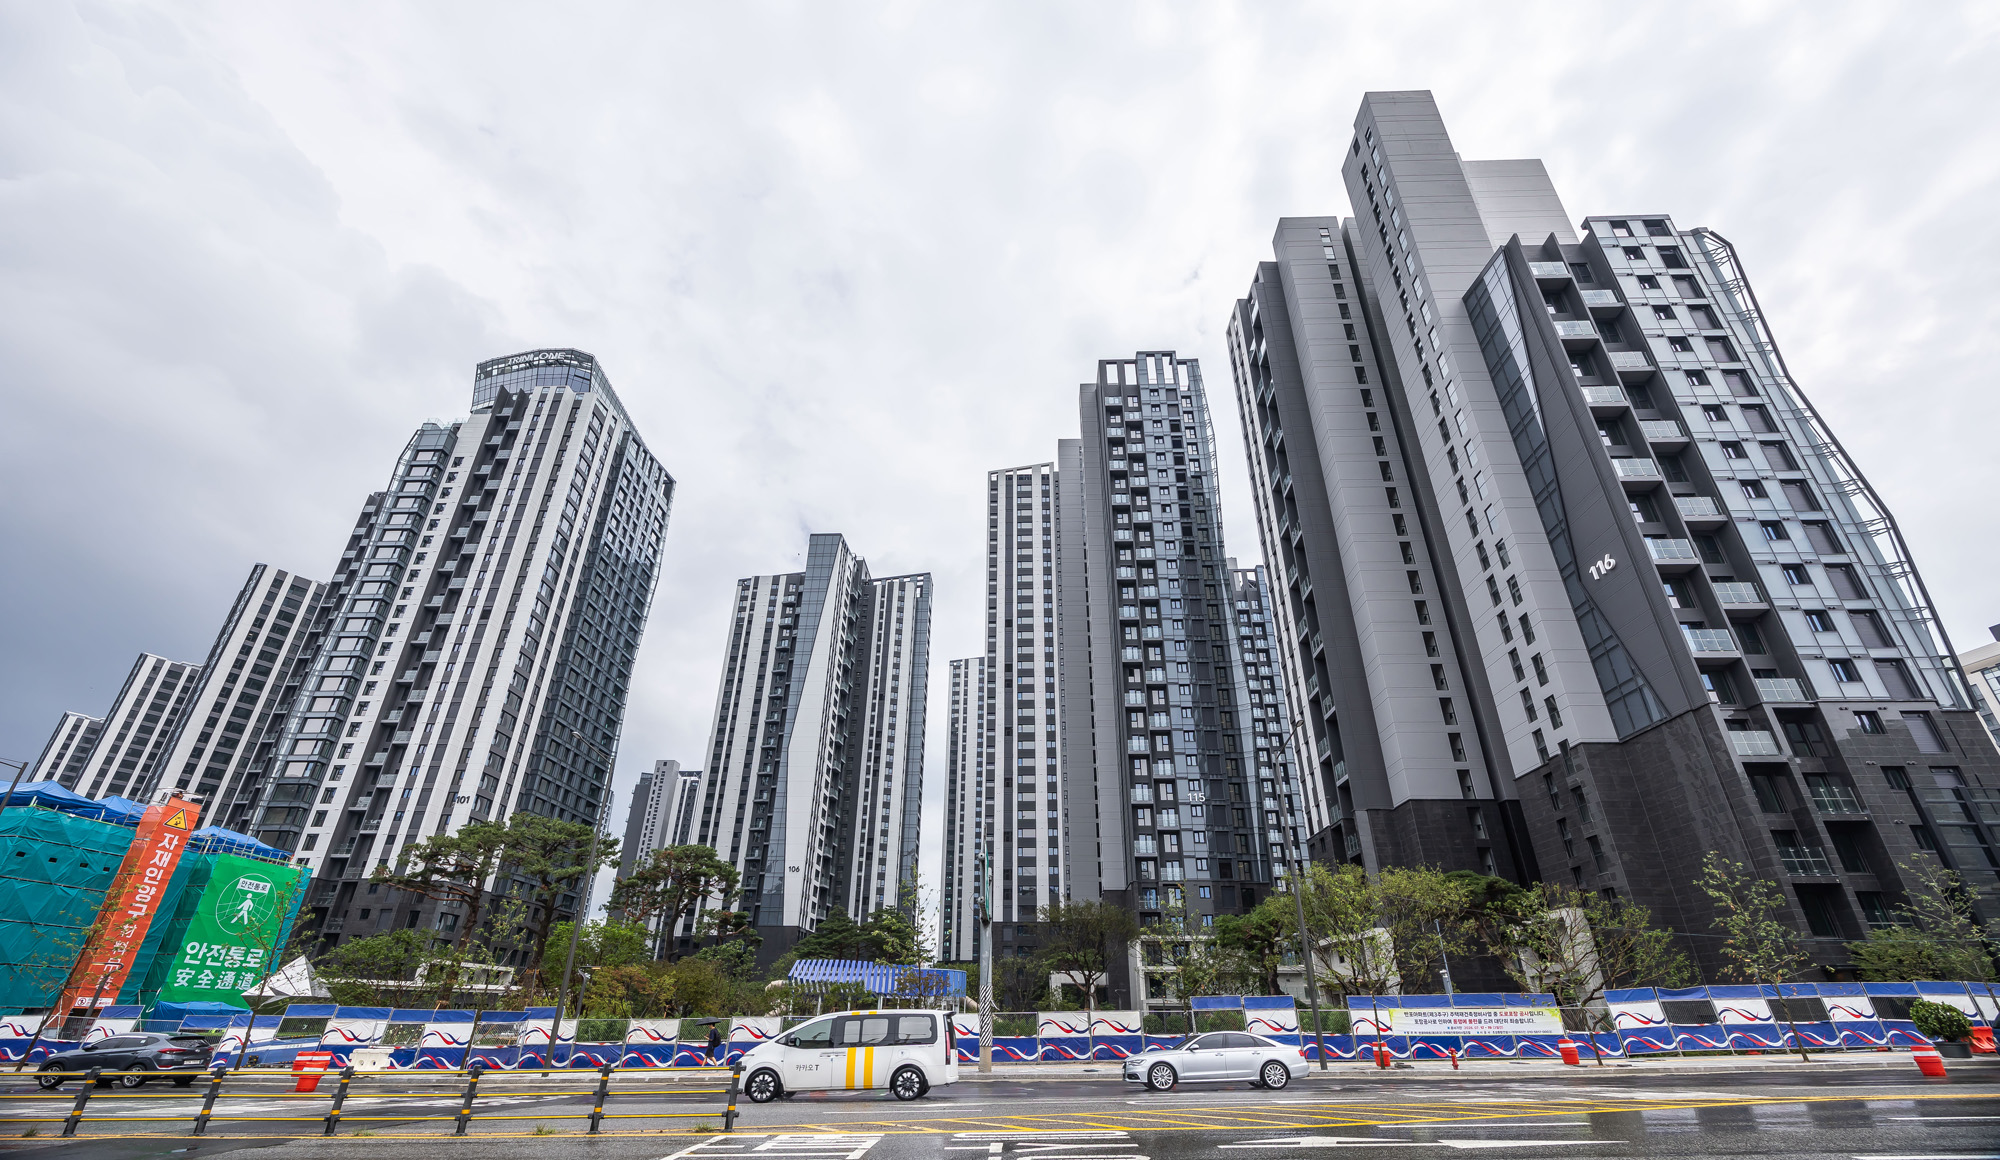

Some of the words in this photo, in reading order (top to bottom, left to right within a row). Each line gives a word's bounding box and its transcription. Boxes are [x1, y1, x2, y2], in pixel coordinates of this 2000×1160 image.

[538, 352, 566, 360] ONE
[1589, 553, 1616, 581] 116
[456, 795, 471, 804] 101
[1187, 792, 1206, 802] 115
[788, 865, 801, 873] 106
[127, 832, 180, 919] 자재인양구
[240, 880, 268, 892] 안전통로
[184, 941, 264, 968] 안전통로
[174, 967, 256, 991] 安全通道
[795, 1064, 813, 1072] 카카오
